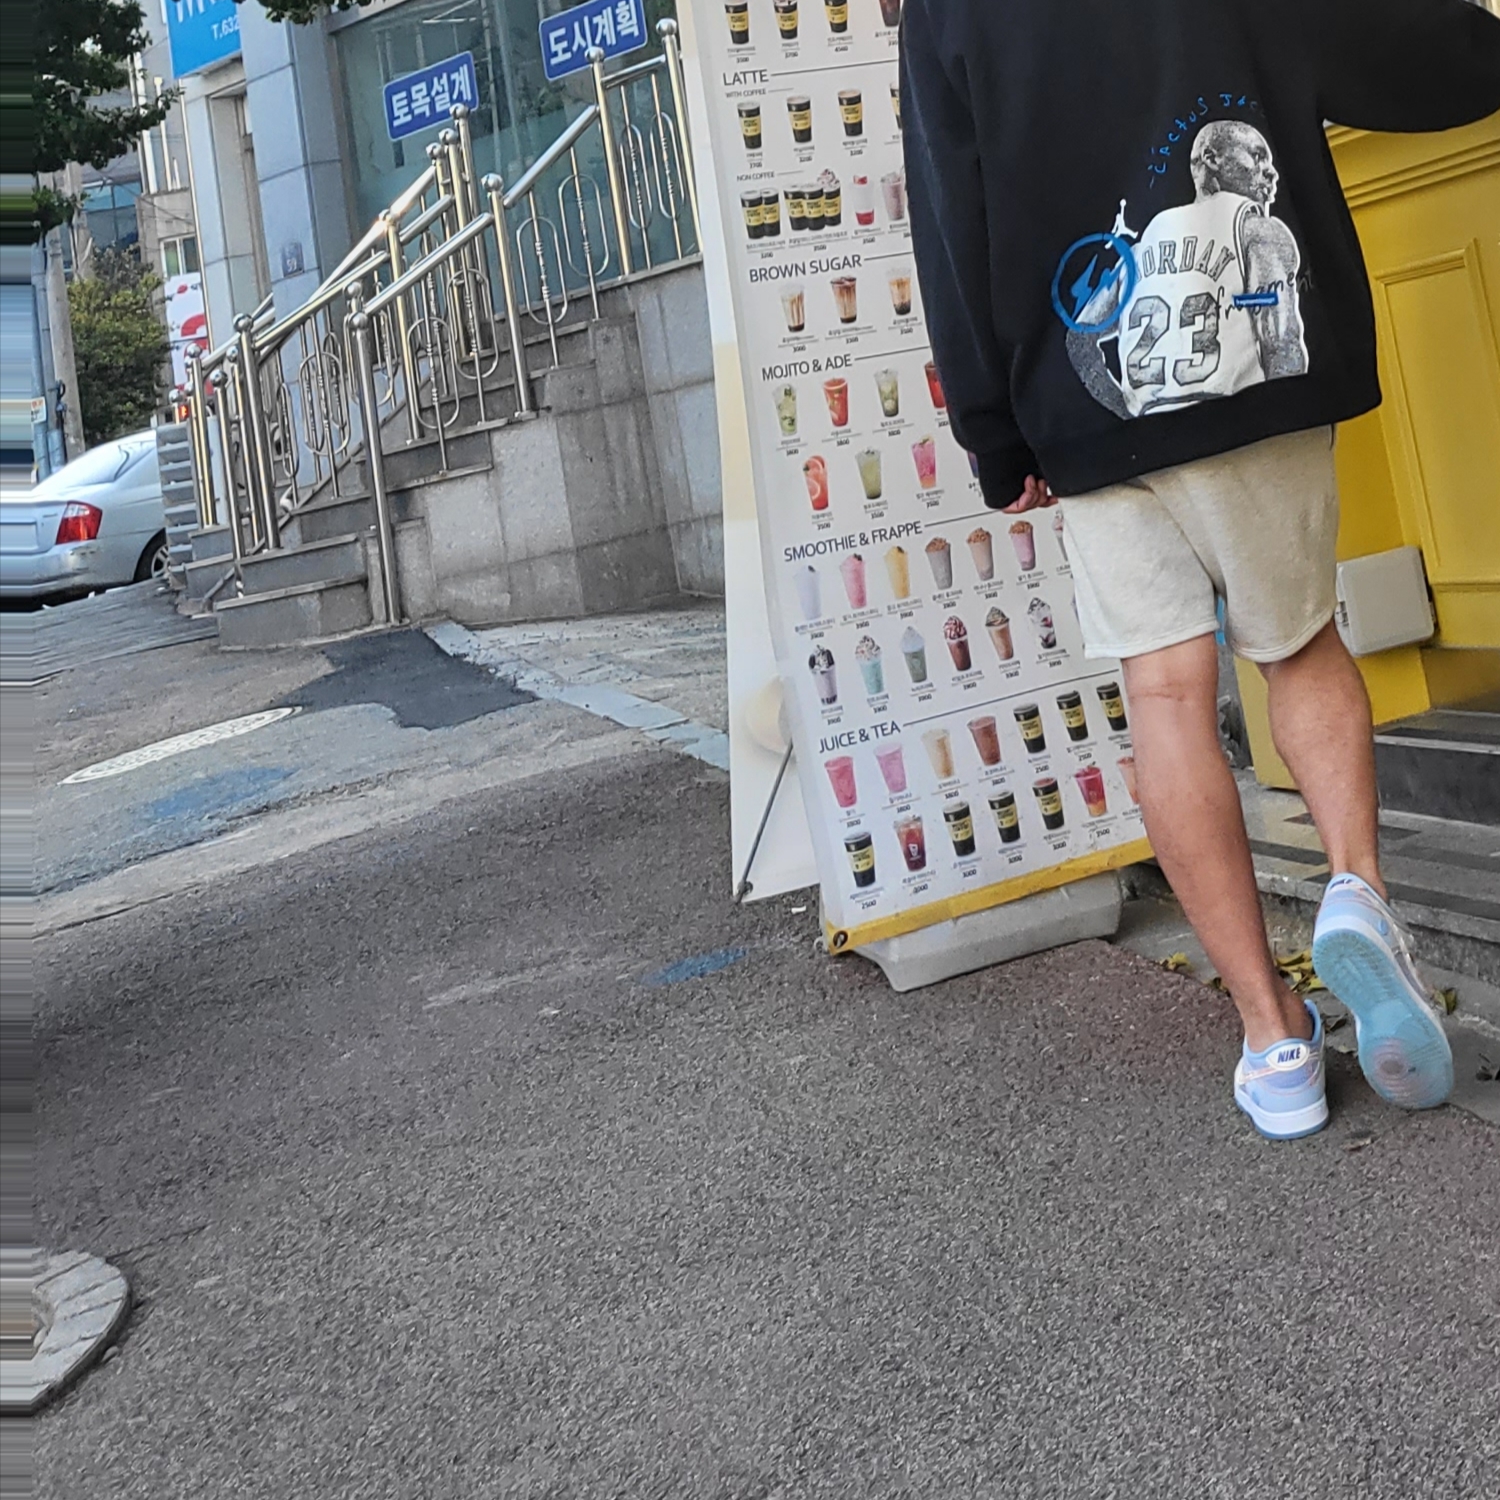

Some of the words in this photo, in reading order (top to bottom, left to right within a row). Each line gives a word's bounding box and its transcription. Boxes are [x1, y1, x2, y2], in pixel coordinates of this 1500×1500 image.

[722, 69, 770, 86] LATTE
[390, 64, 472, 124] 토목설계
[749, 261, 807, 283] BROWN
[809, 254, 862, 275] SUGAR
[1126, 290, 1224, 391] 23
[761, 360, 810, 382] MOJITO
[812, 358, 823, 374] &
[824, 353, 853, 371] ADE
[784, 534, 857, 563] SMOOTHIE
[859, 531, 870, 547] &
[871, 520, 924, 544] FRAPPE
[818, 729, 857, 755] JUICE
[858, 727, 871, 744] &
[870, 719, 902, 740] TEA
[1276, 1046, 1302, 1064] NIKE
